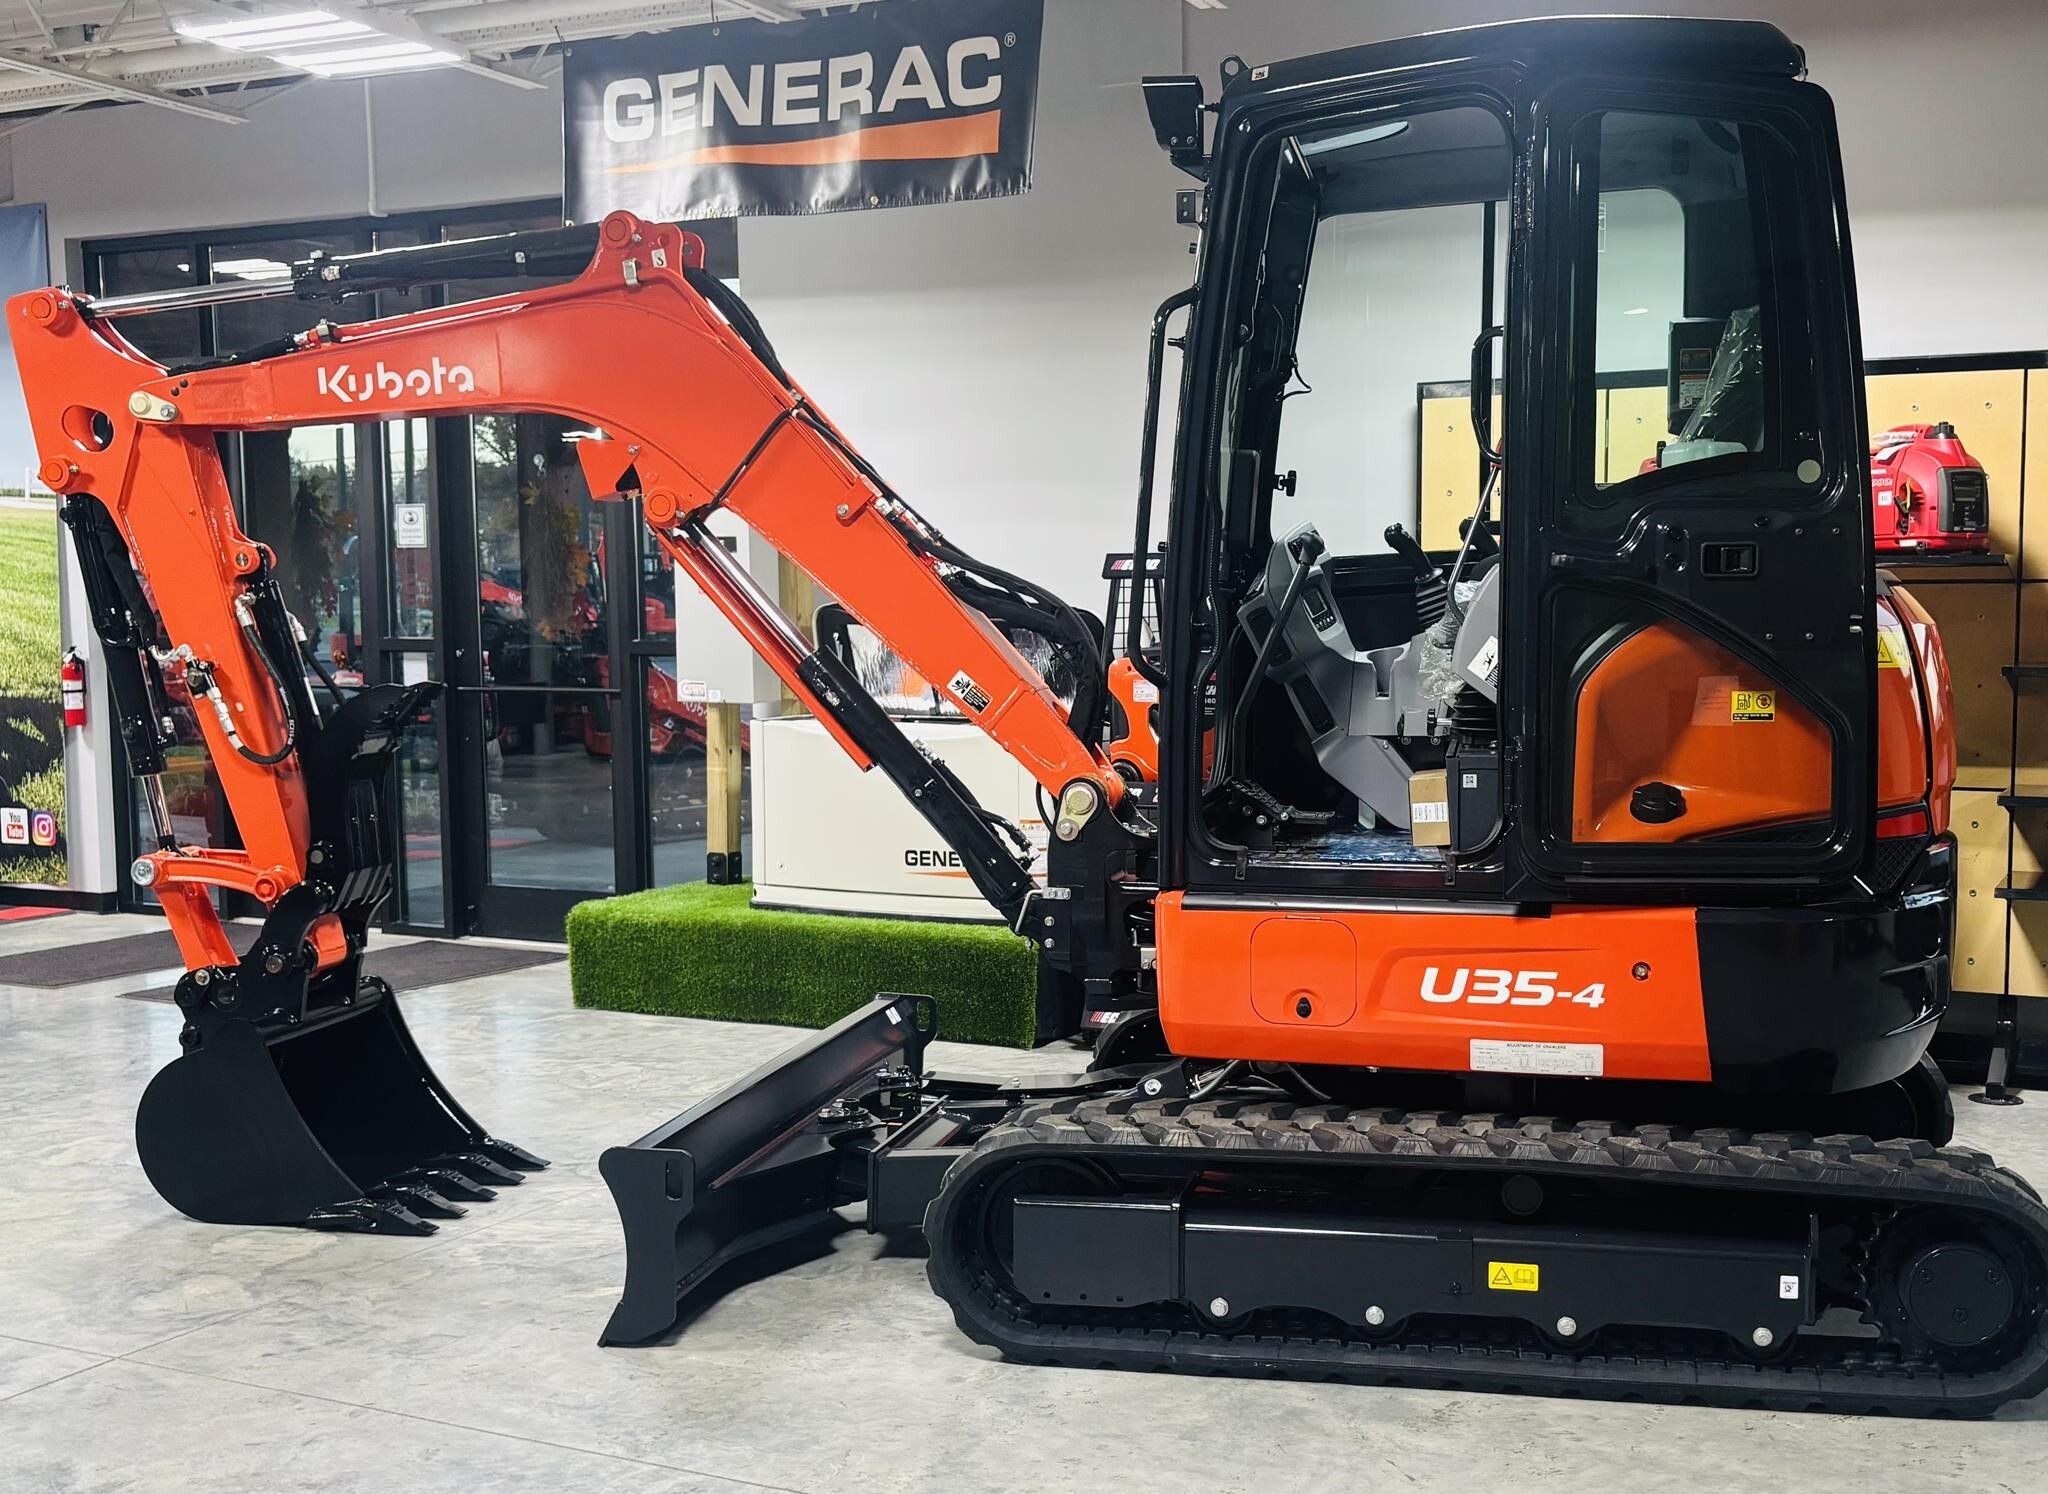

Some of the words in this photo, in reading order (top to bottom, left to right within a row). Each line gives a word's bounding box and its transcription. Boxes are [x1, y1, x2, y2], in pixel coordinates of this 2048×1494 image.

[603, 35, 1001, 143] GENERAC
[317, 356, 475, 403] Kubota
[9, 812, 21, 823] You
[904, 849, 966, 867] GENE
[1419, 967, 1605, 1008] U35-4
